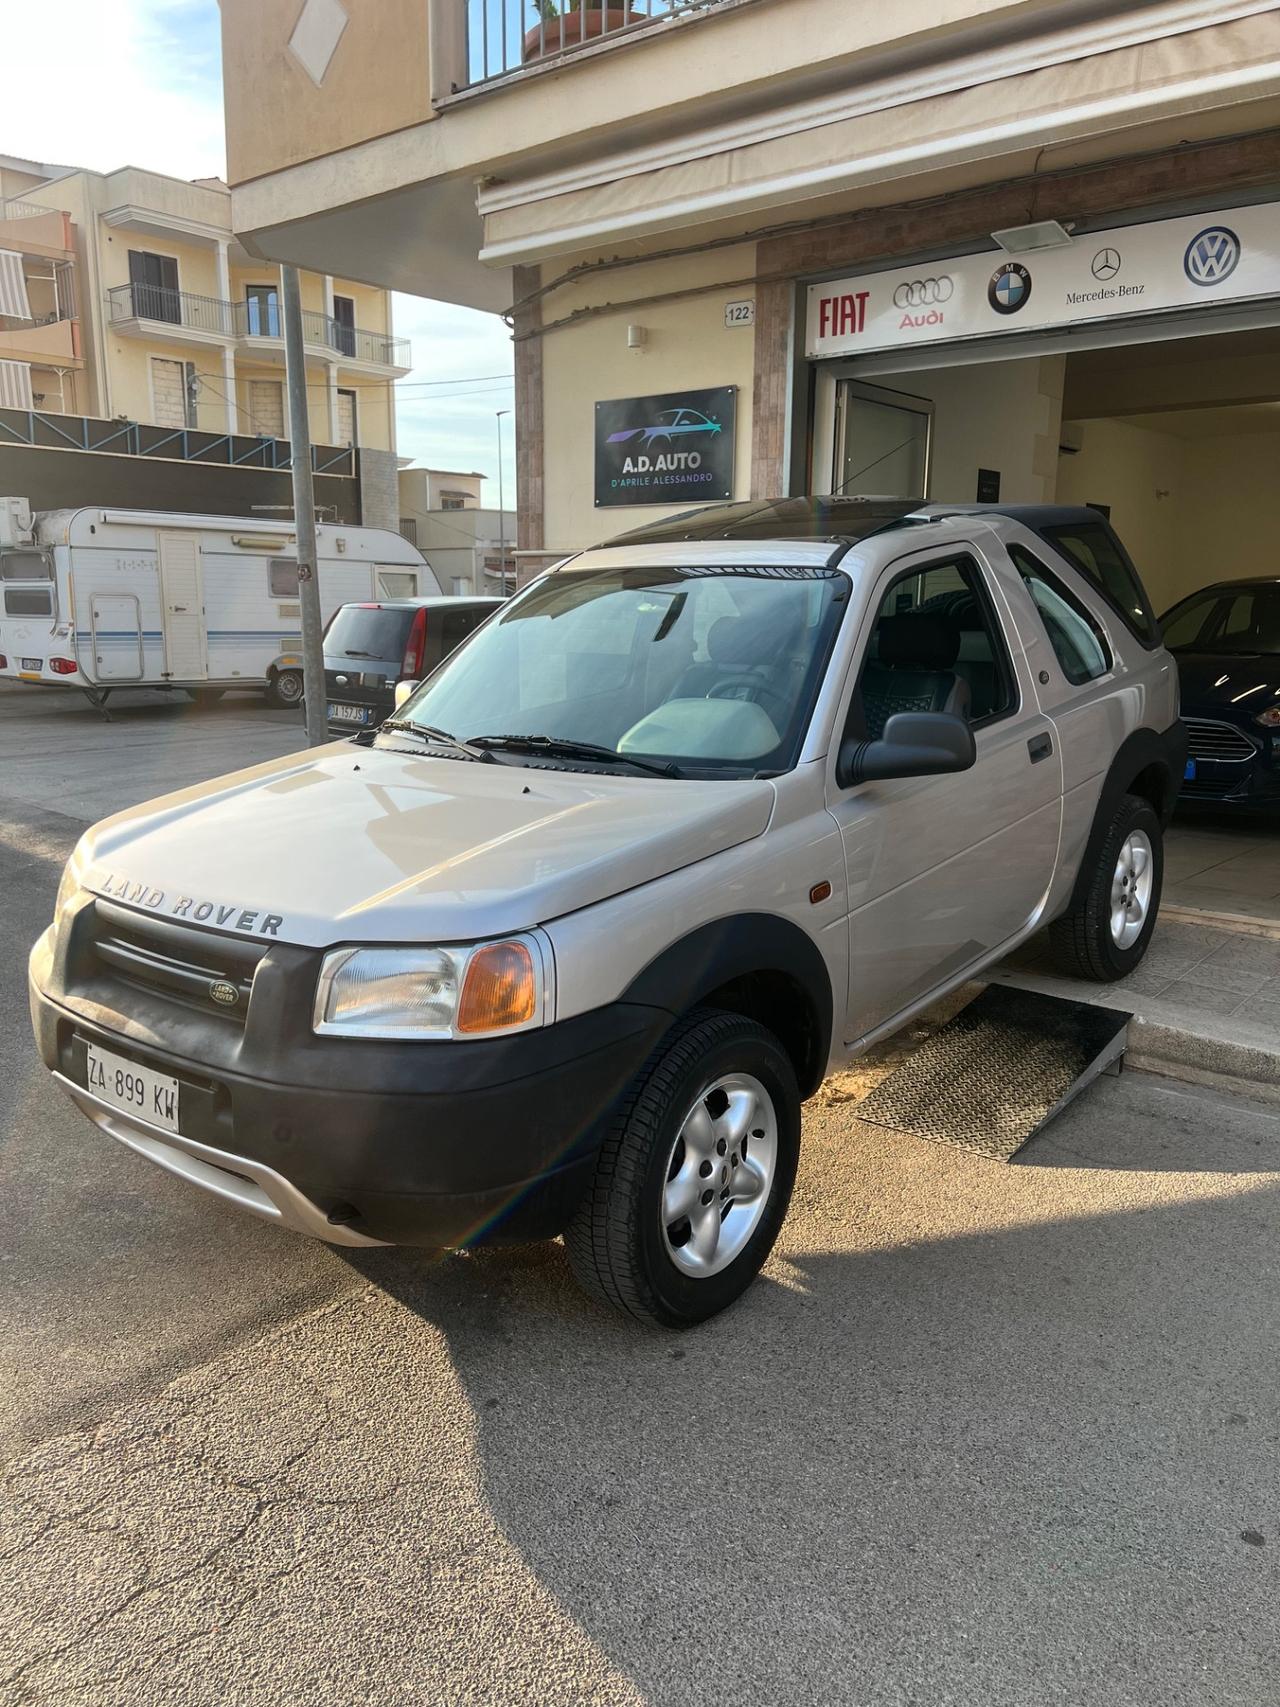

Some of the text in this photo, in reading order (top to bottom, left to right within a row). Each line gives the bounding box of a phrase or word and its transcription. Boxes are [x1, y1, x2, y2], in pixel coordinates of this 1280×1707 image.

[1066, 284, 1145, 305] Mercedes-Benz
[729, 306, 749, 320] 122
[820, 291, 870, 338] FIAT
[899, 309, 944, 329] Audi
[611, 472, 713, 488] D'APRILE ALESSANDRO
[101, 874, 284, 935] LAND ROVER
[89, 1056, 175, 1120] ZA 899 KW
